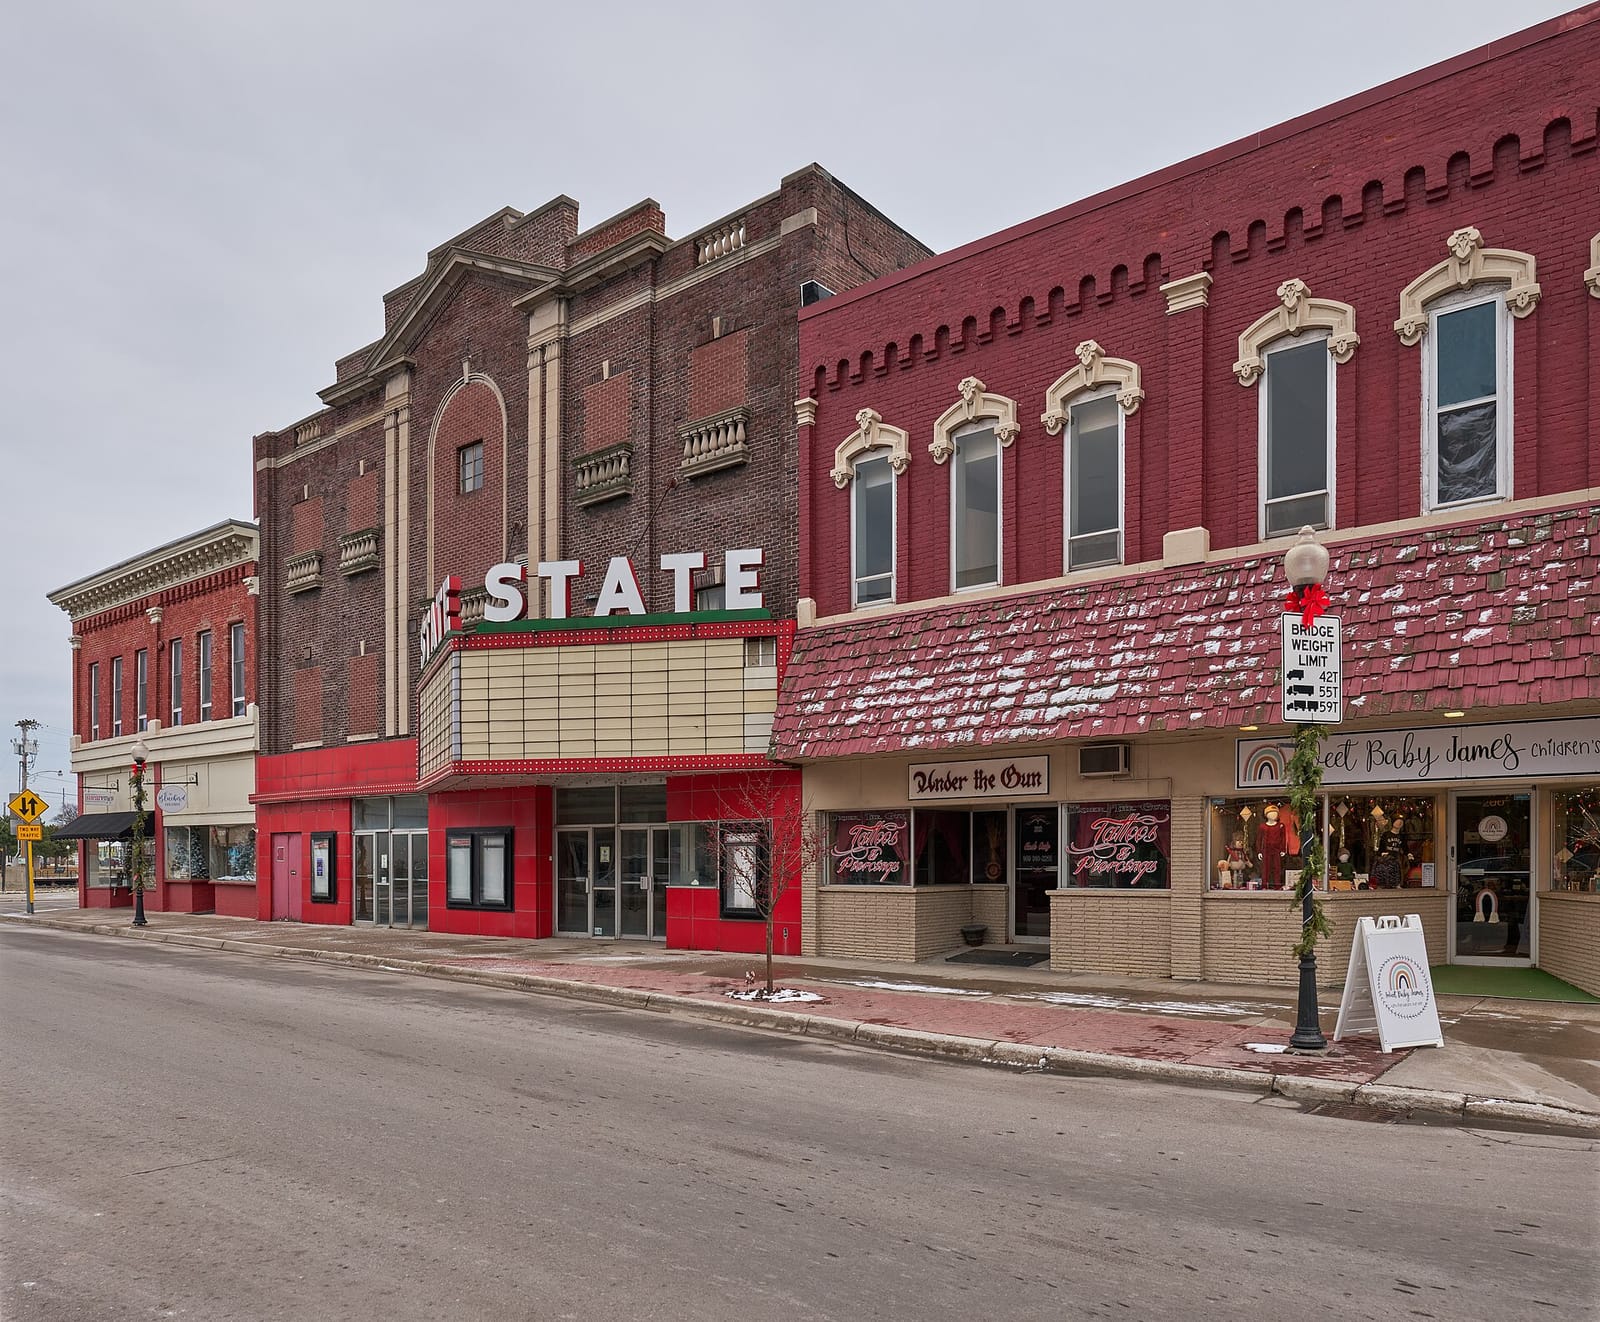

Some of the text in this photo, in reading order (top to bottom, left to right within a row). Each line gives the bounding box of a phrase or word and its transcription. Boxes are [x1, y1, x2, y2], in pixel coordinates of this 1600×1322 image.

[483, 548, 765, 623] STATE
[1291, 624, 1334, 637] BRIDGE
[1291, 639, 1335, 652] WEIGHT
[1298, 654, 1328, 667] LIMIT
[1319, 671, 1338, 683] 42T
[1319, 686, 1338, 698] 55T
[1319, 701, 1338, 713] 59T
[1315, 739, 1359, 771] eet
[1366, 732, 1439, 777] Baby
[1446, 733, 1526, 770] James
[913, 763, 1042, 794] Under the Gun
[845, 821, 907, 848] Tattoos
[1089, 813, 1169, 845] Tattoos
[1116, 846, 1131, 860] &
[837, 856, 900, 882] Piercings
[1073, 856, 1158, 885] Piercings
